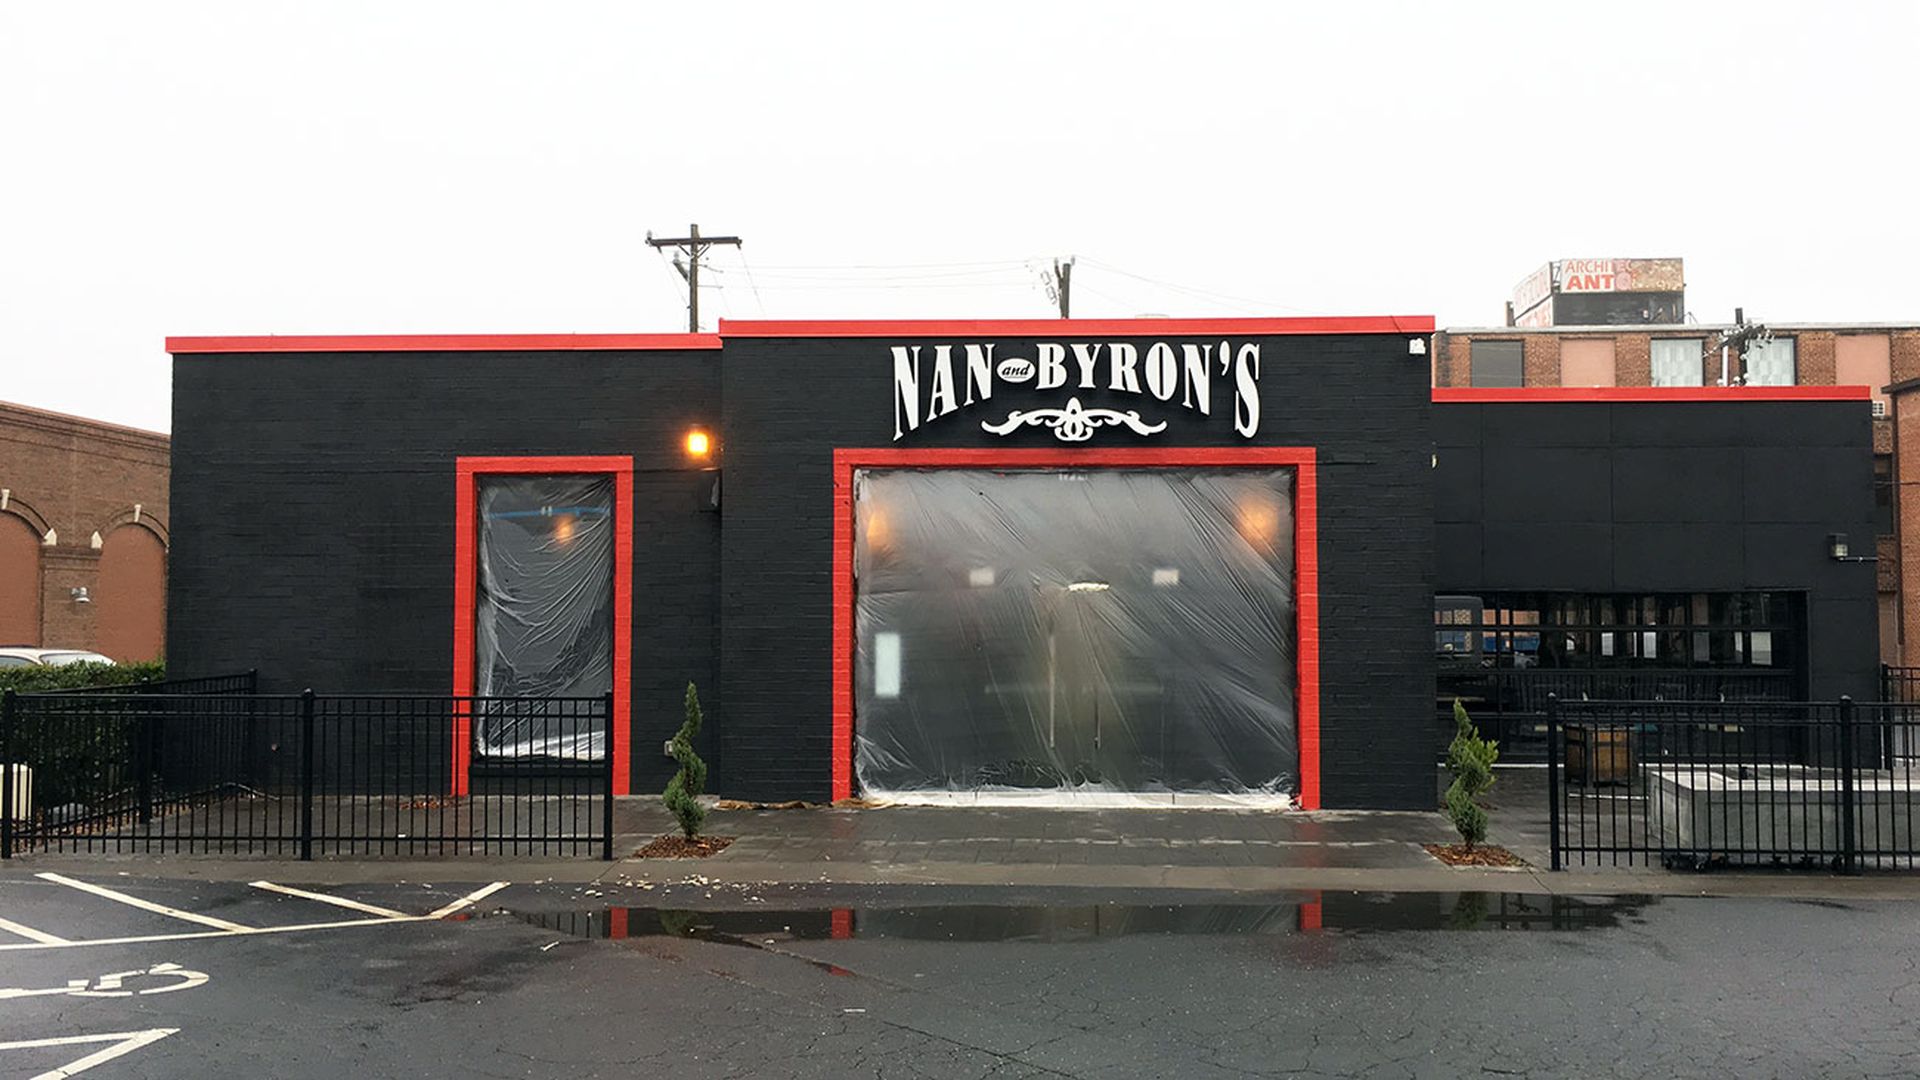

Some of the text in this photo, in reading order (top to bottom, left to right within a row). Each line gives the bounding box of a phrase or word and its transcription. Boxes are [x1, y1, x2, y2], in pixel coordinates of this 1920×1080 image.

[891, 340, 1261, 441] NAN and BYRON'S
